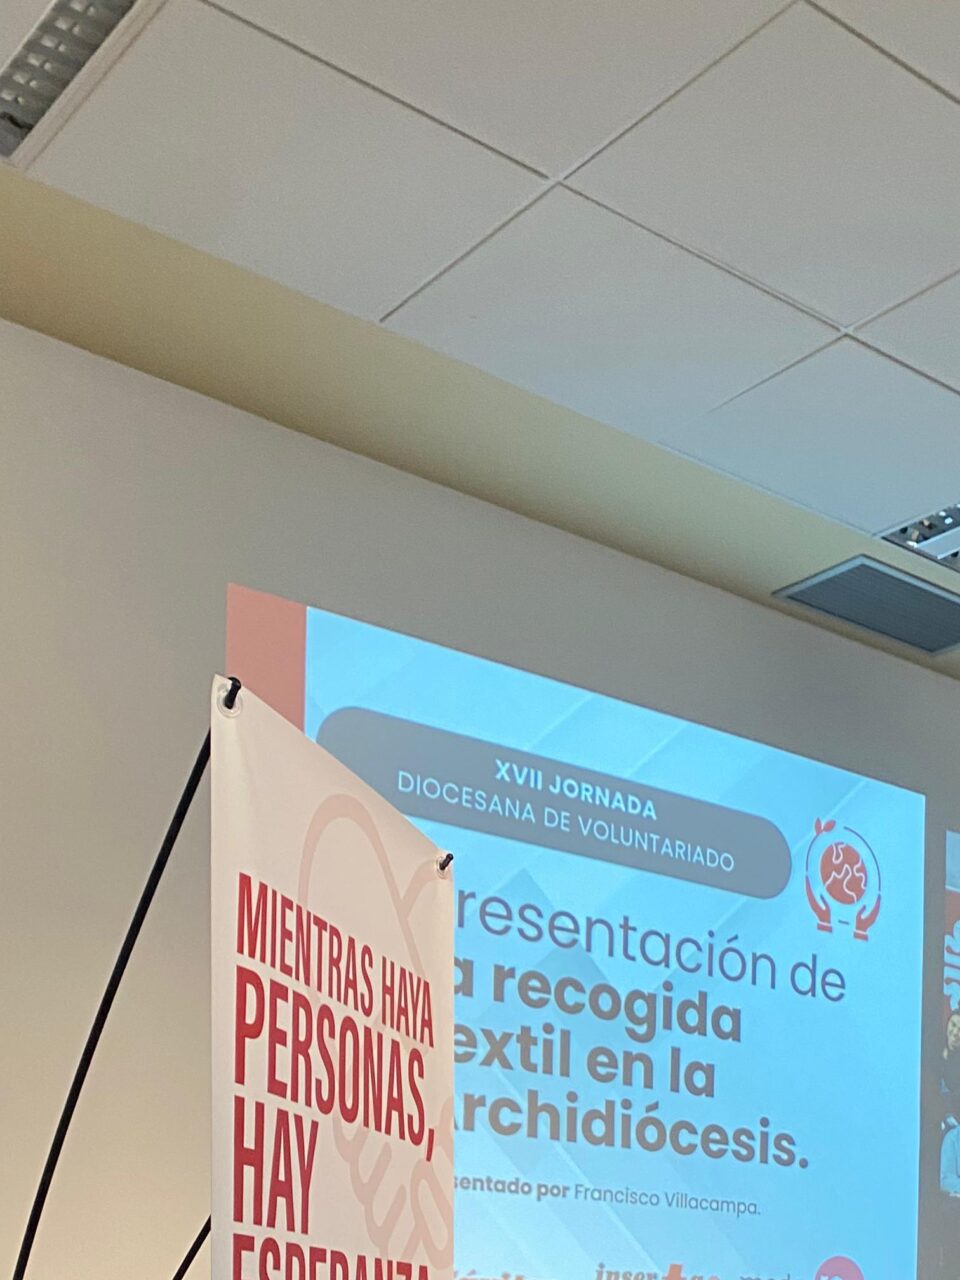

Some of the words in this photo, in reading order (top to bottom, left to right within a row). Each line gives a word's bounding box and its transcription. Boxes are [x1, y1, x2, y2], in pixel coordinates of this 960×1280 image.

[398, 770, 535, 823] DIOCESANA
[544, 807, 570, 832] DE
[578, 815, 734, 872] VOLUNTARIADO
[495, 759, 543, 790] XVII
[549, 775, 656, 820] JORNADA
[236, 871, 373, 1018] MIENTRAS
[382, 955, 434, 1048] HAYA
[455, 889, 776, 990] resentación
[790, 953, 846, 1002] de
[453, 956, 474, 998] a
[493, 963, 741, 1043] recogida
[234, 964, 435, 1163] PERSONAS,
[453, 1022, 570, 1078] extil
[587, 1046, 654, 1089] en
[670, 1046, 716, 1098] la
[233, 1095, 319, 1235] HAY
[453, 1088, 809, 1170] rchidiócesis.
[537, 1183, 570, 1202] por
[574, 1184, 660, 1206] Francisco
[665, 1192, 762, 1218] Villacampa.
